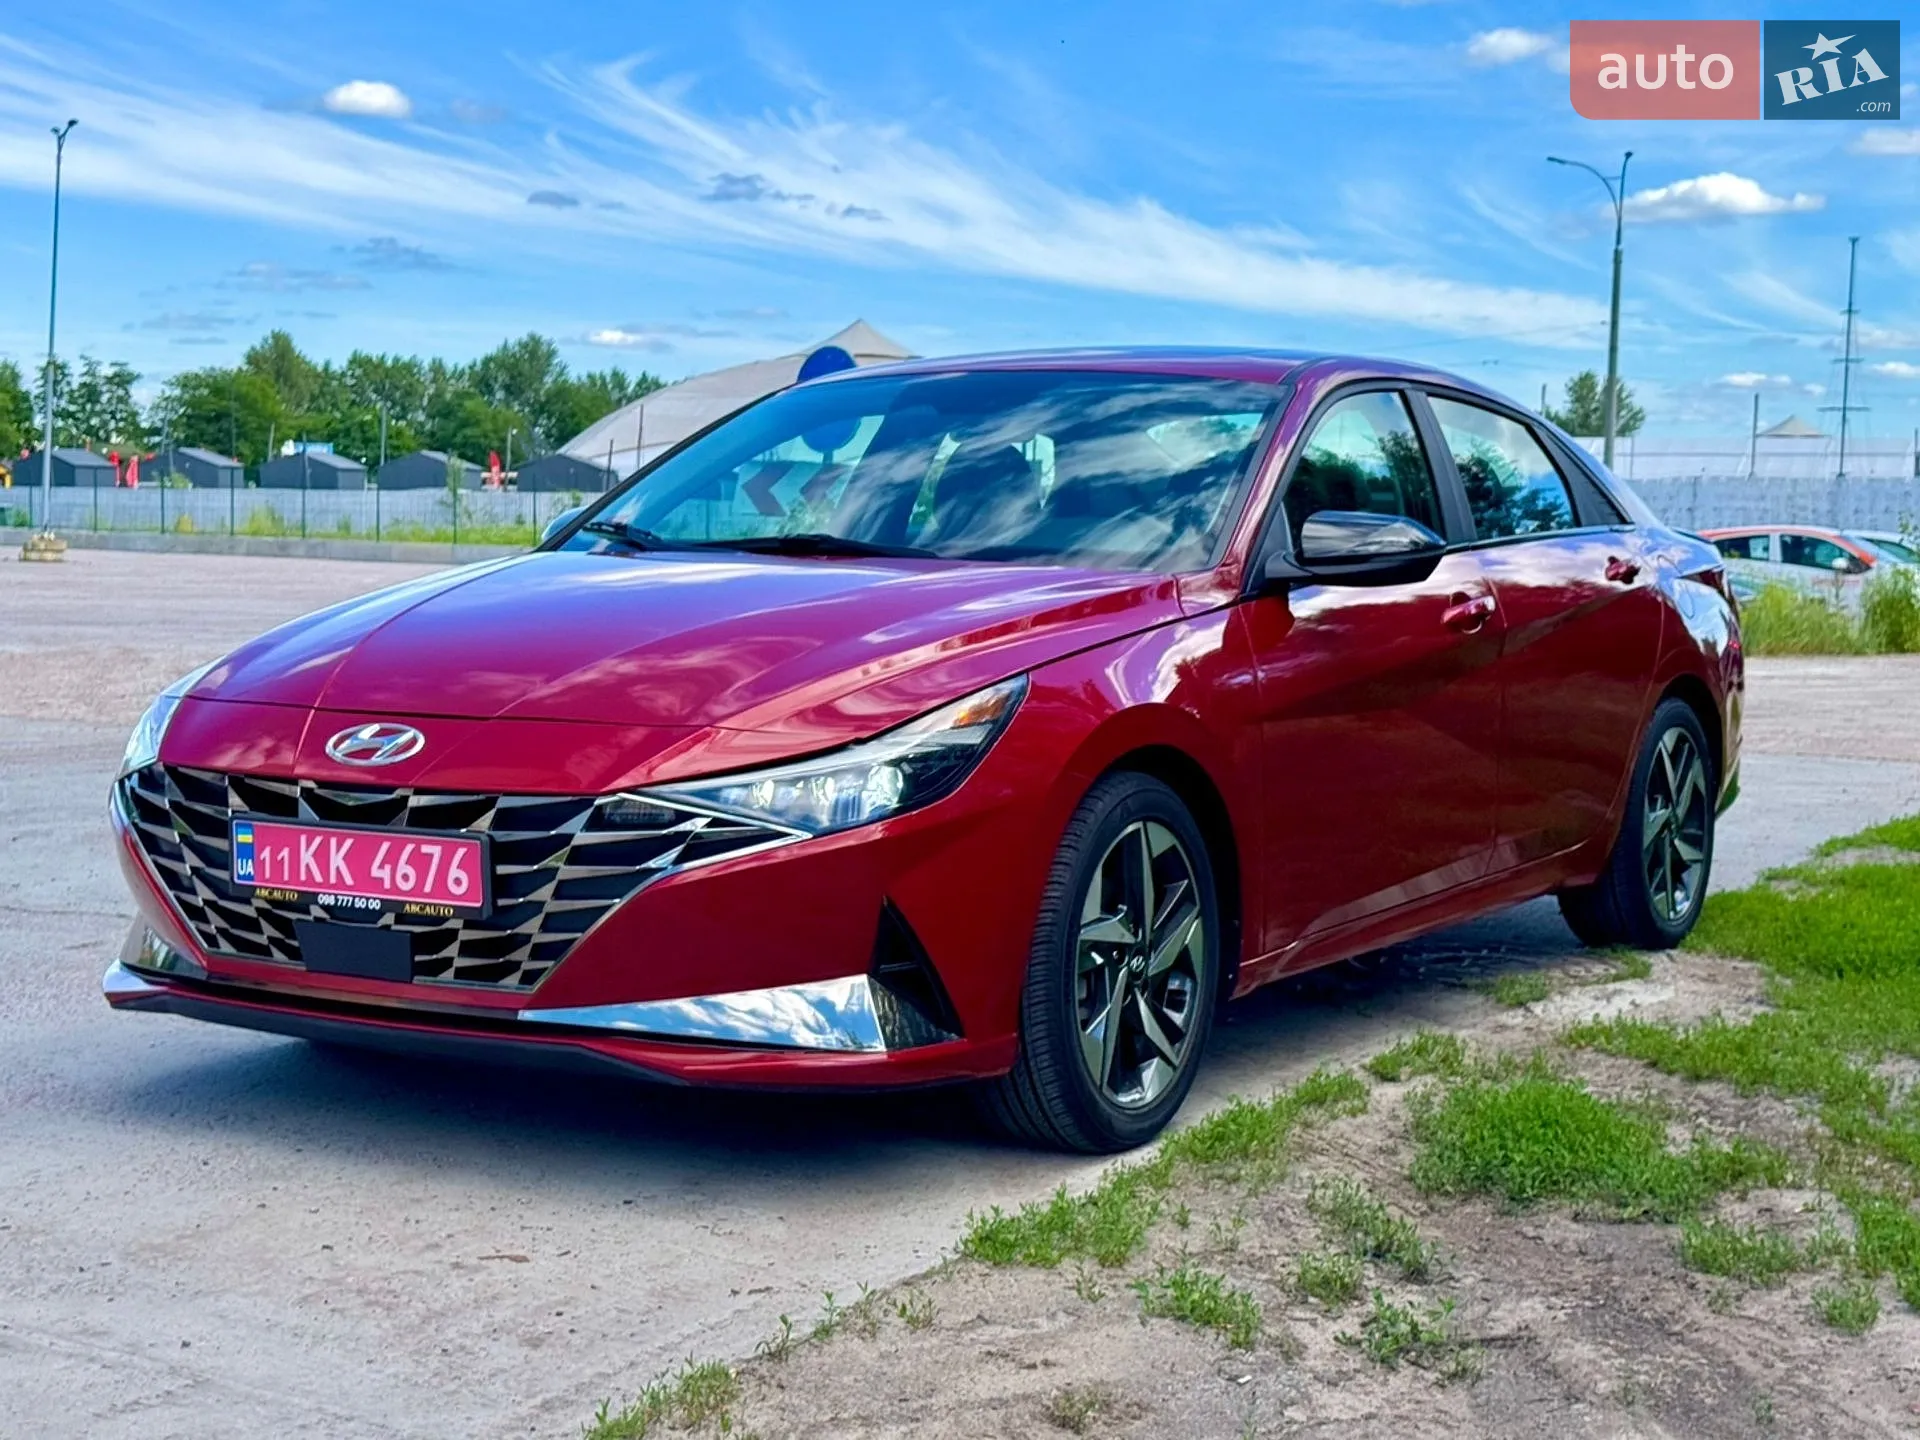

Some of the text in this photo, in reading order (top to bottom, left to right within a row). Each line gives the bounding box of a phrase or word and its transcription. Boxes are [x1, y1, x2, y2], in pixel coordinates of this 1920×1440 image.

[238, 858, 254, 876] UA
[370, 841, 469, 896] 4676
[336, 895, 353, 907] 777
[368, 898, 381, 910] 00
